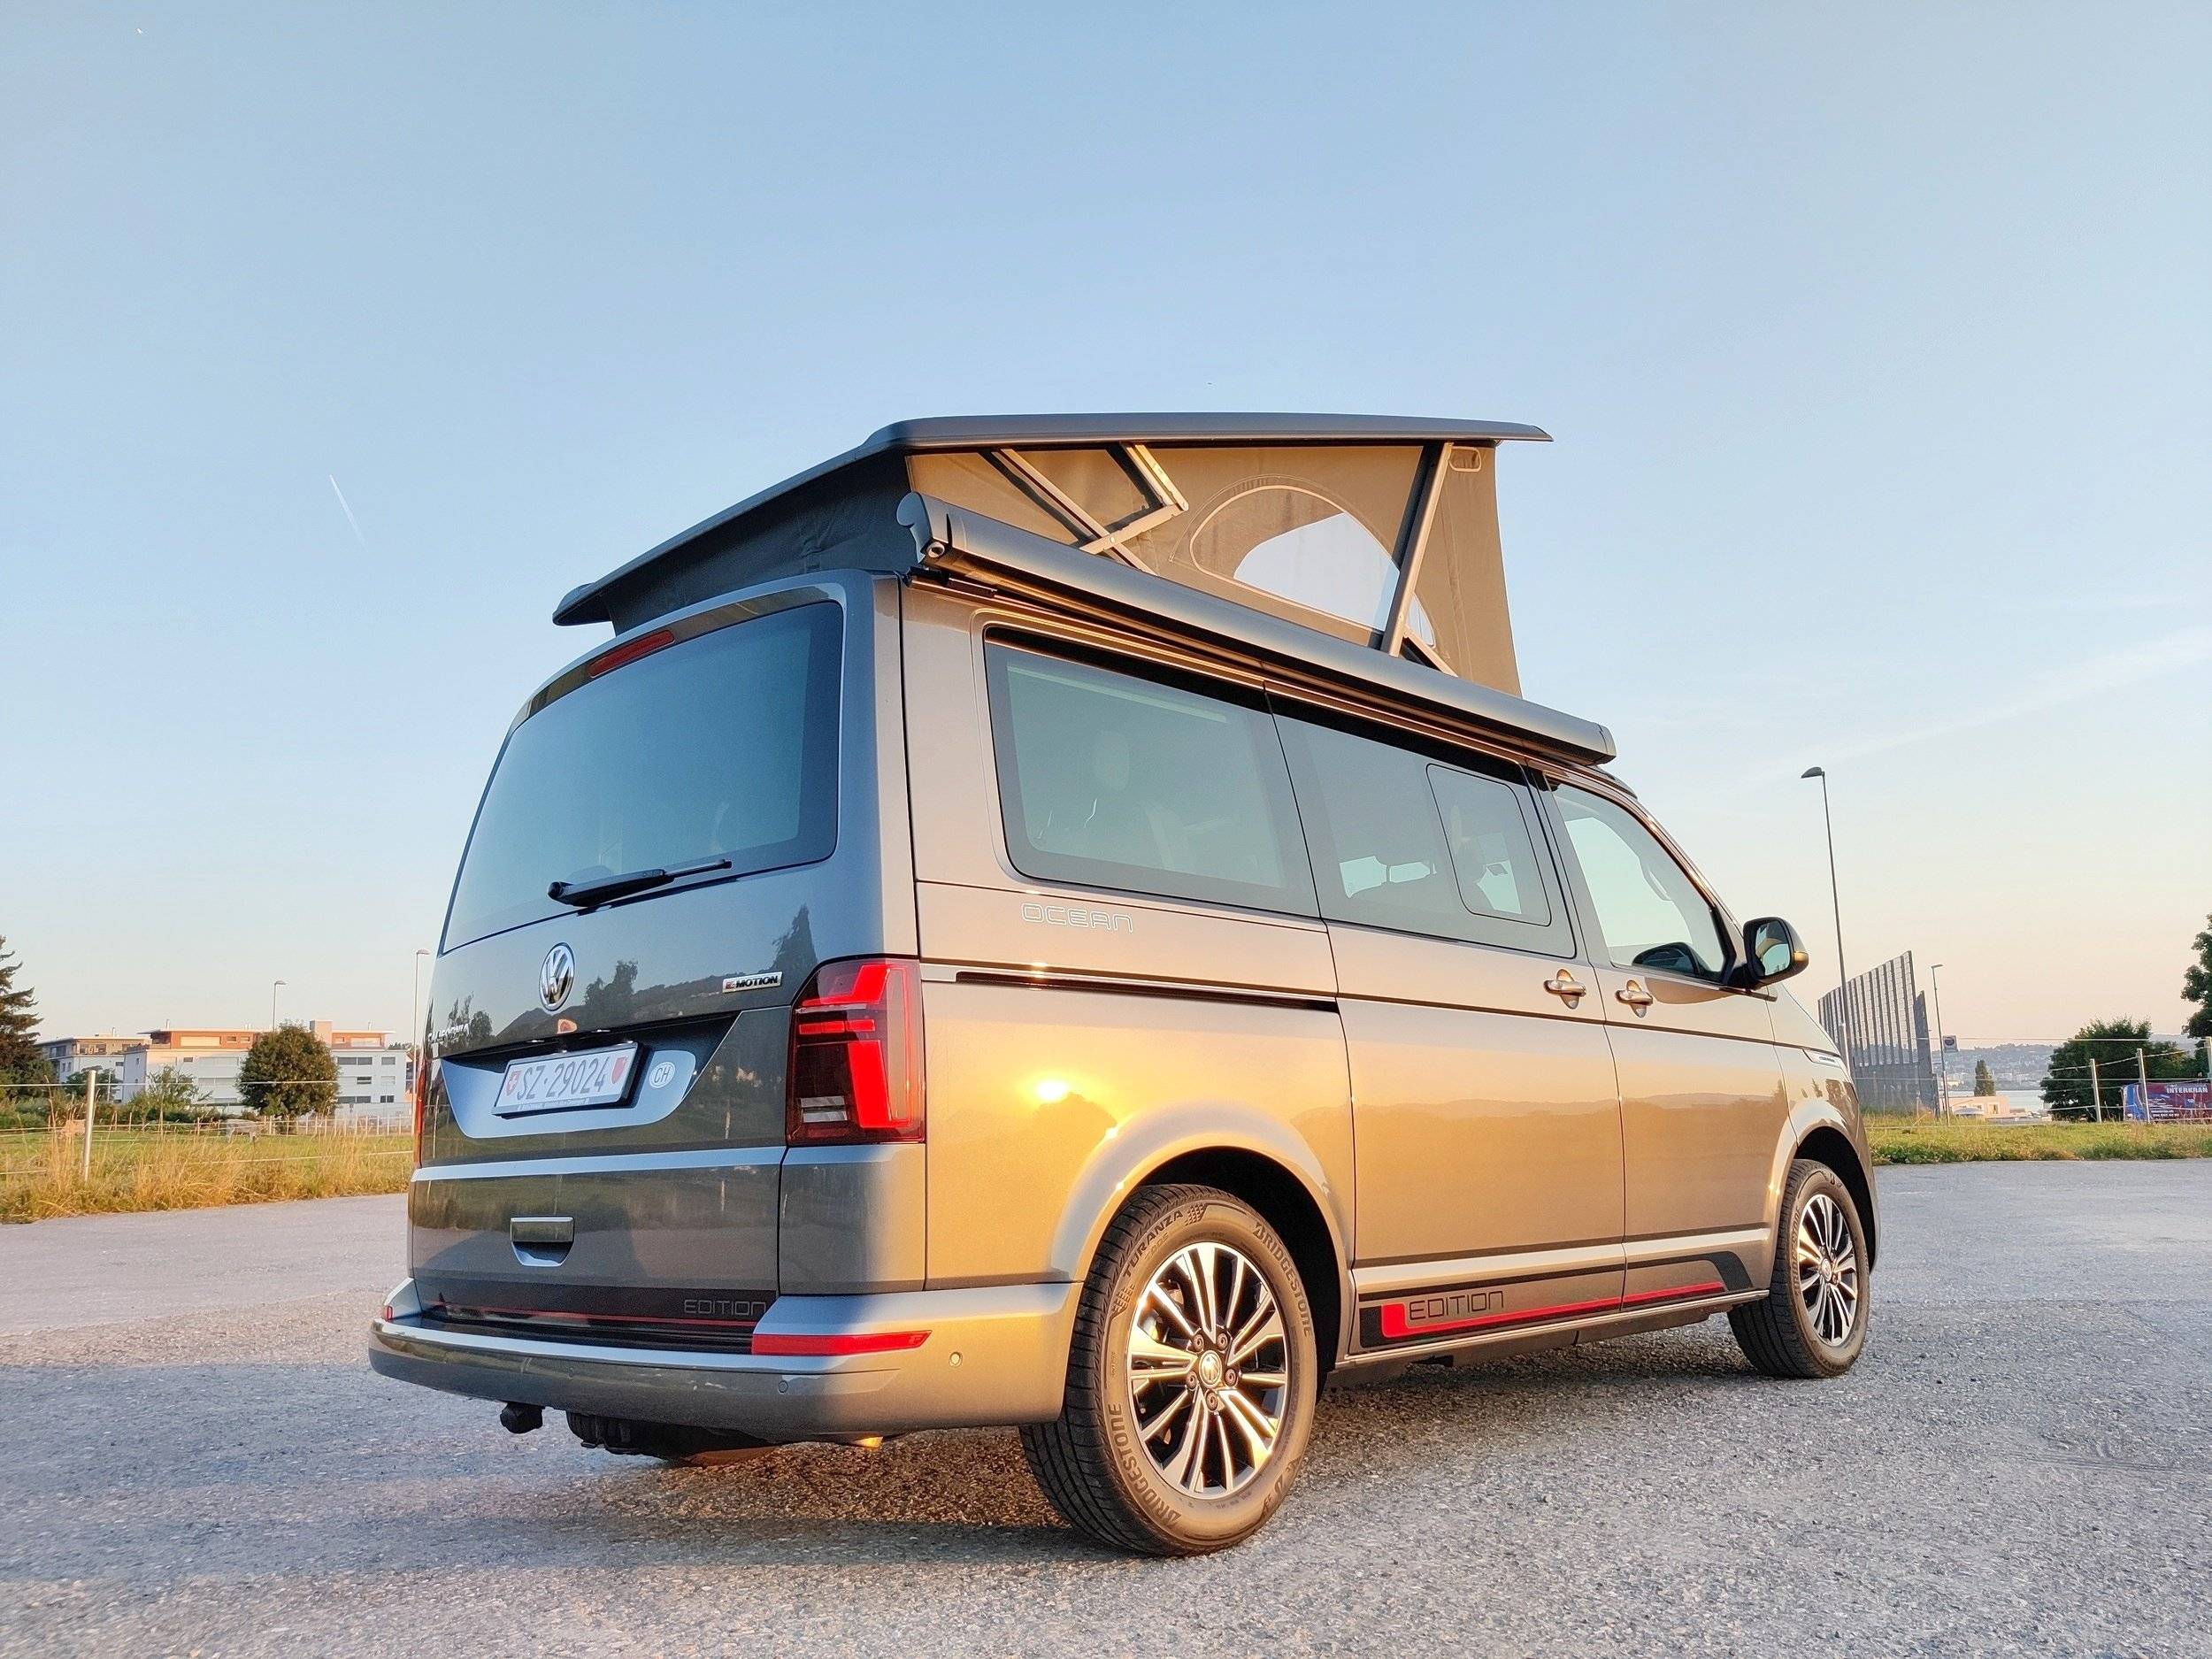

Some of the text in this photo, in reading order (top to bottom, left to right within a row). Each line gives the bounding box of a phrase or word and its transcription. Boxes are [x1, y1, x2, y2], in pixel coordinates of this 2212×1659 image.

[1021, 902, 1133, 933] OCEAN
[655, 1064, 671, 1084] CH
[1123, 1210, 1184, 1279] TURANZA
[1252, 1222, 1311, 1338] BRIDGESTONE
[684, 1299, 766, 1316] EDITION
[1409, 1290, 1504, 1321] EDITION
[1108, 1403, 1182, 1528] BRIDGESTONE
